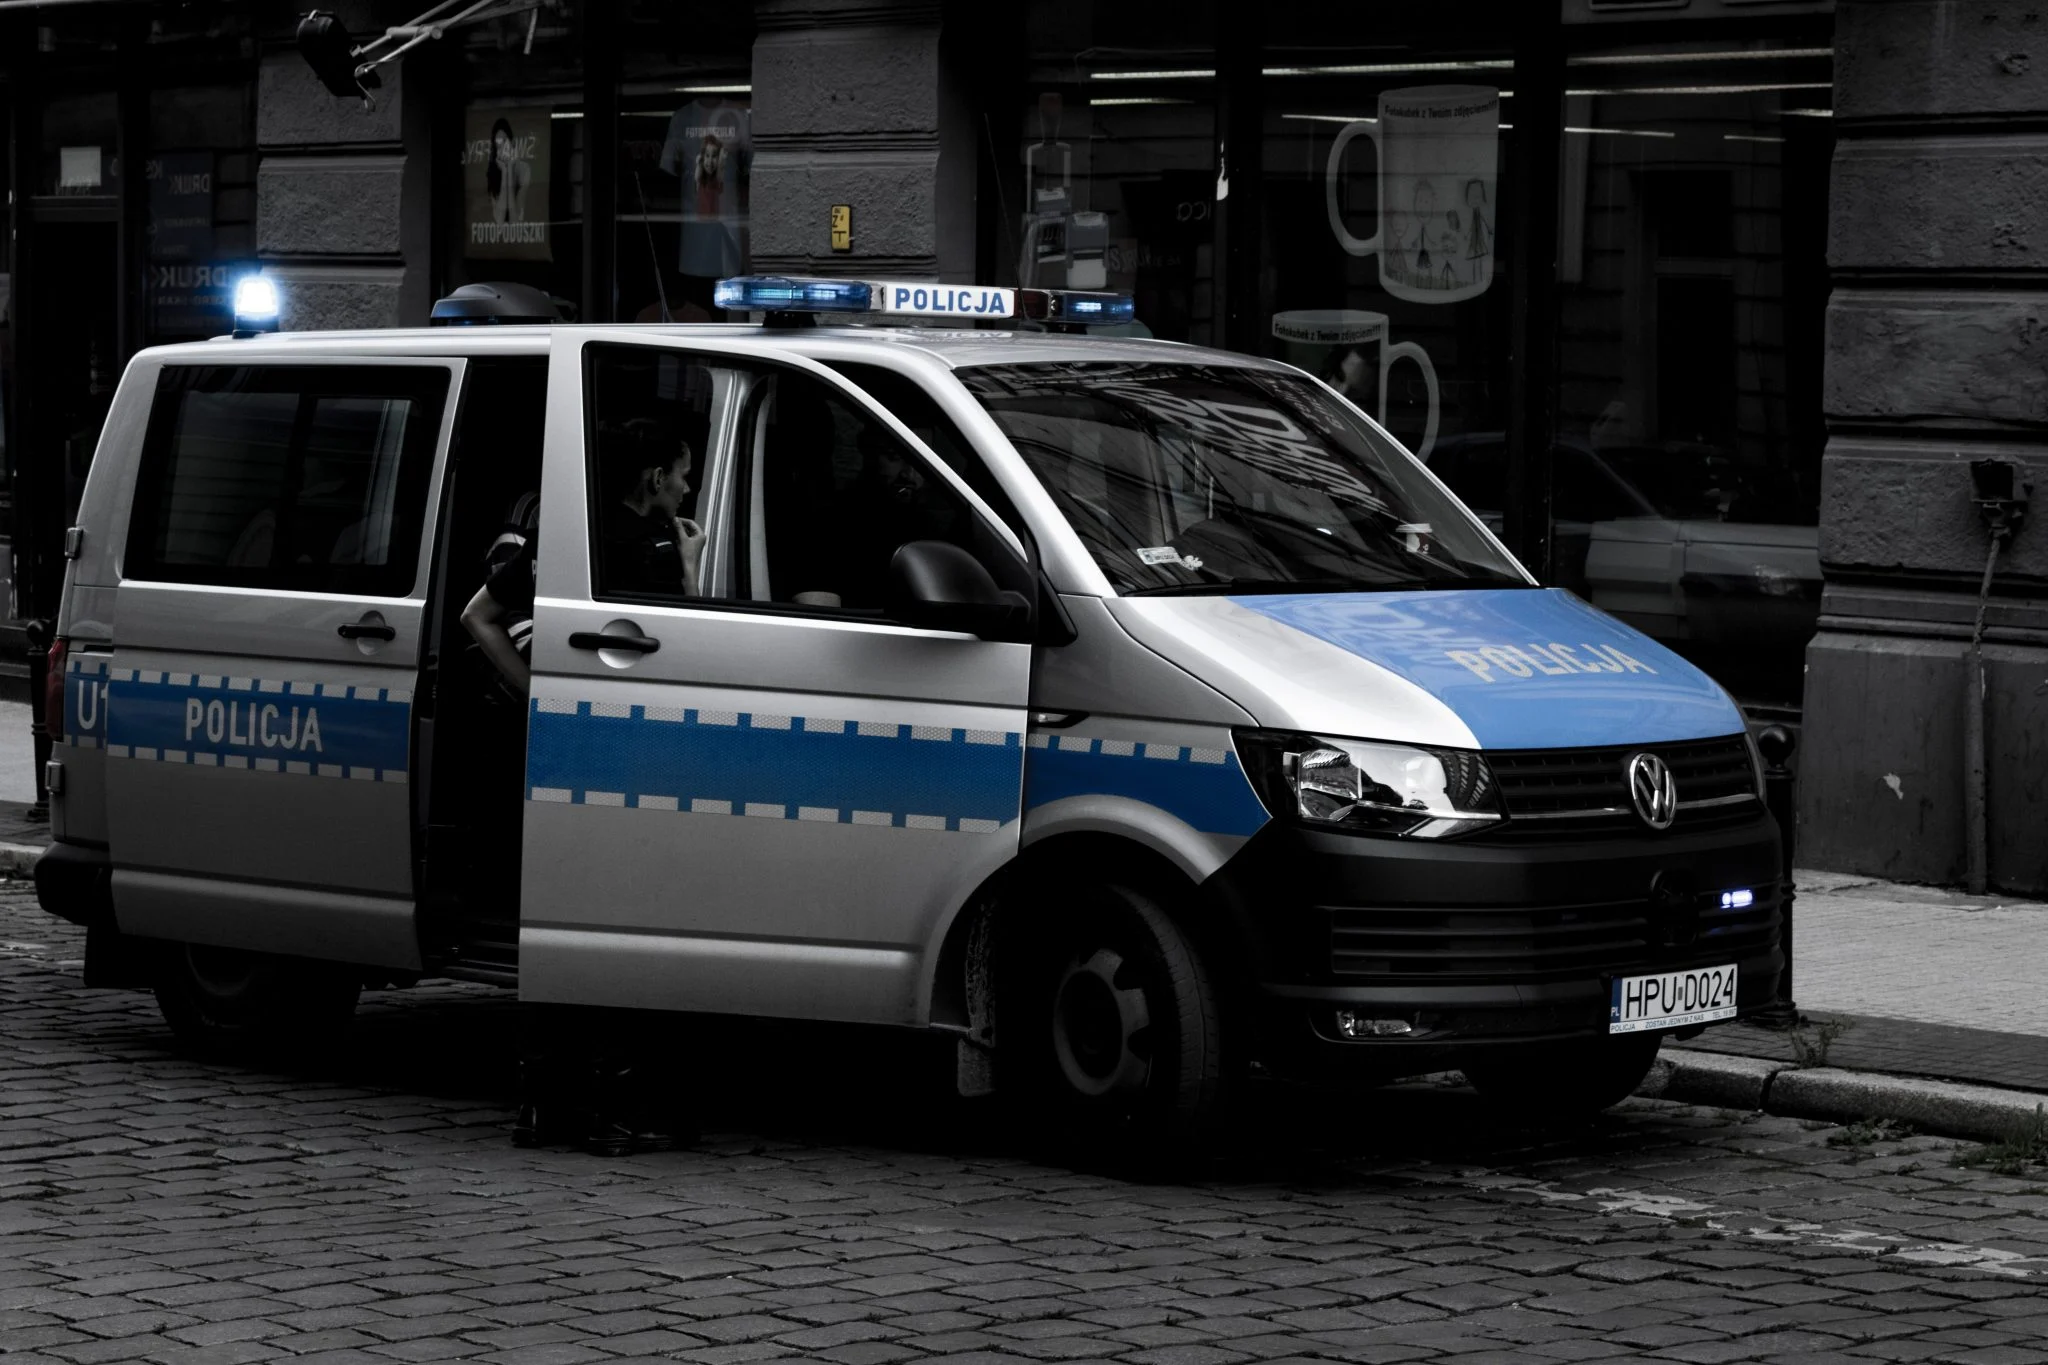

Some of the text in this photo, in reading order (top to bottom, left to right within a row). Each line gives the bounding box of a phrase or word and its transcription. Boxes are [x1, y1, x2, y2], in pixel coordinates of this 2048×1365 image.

[471, 221, 545, 244] FOTOPODUSZKI
[895, 286, 1006, 314] POLICJA
[1444, 642, 1660, 683] POLICJA
[185, 697, 324, 753] POLICJA
[1610, 1006, 1620, 1017] PL
[1610, 1023, 1636, 1033] POLICJA
